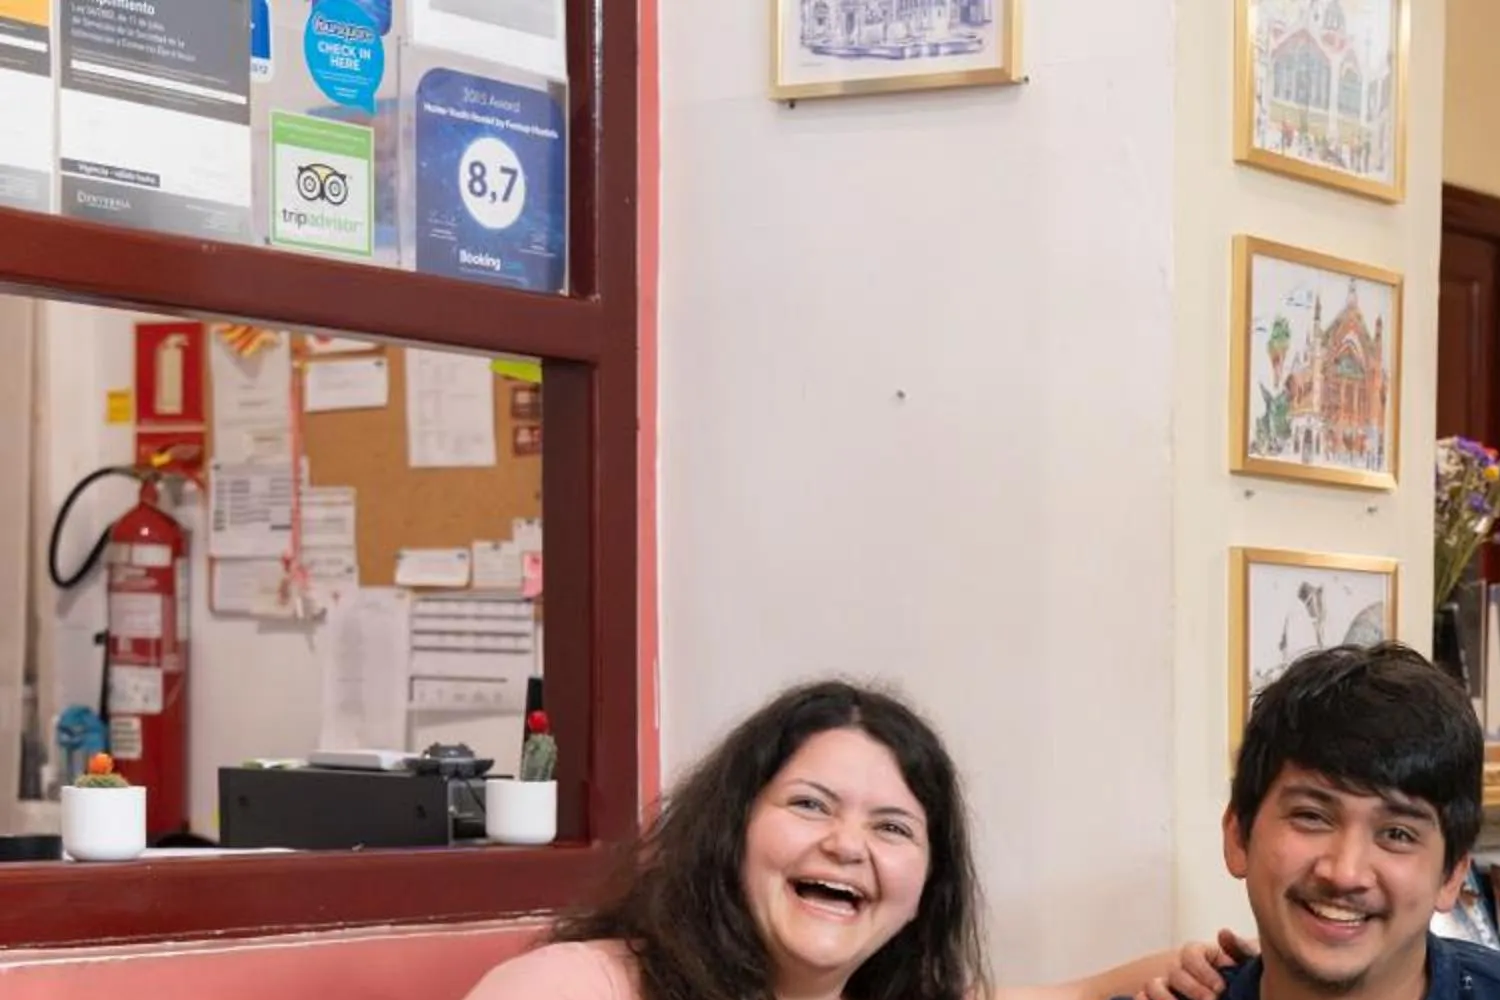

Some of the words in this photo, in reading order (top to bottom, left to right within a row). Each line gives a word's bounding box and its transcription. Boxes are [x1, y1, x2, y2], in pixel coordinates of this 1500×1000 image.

[317, 40, 357, 57] CHECK
[359, 47, 371, 60] IN
[330, 56, 361, 71] HERE
[468, 160, 519, 203] 8,7
[282, 208, 358, 231] tripadvisor
